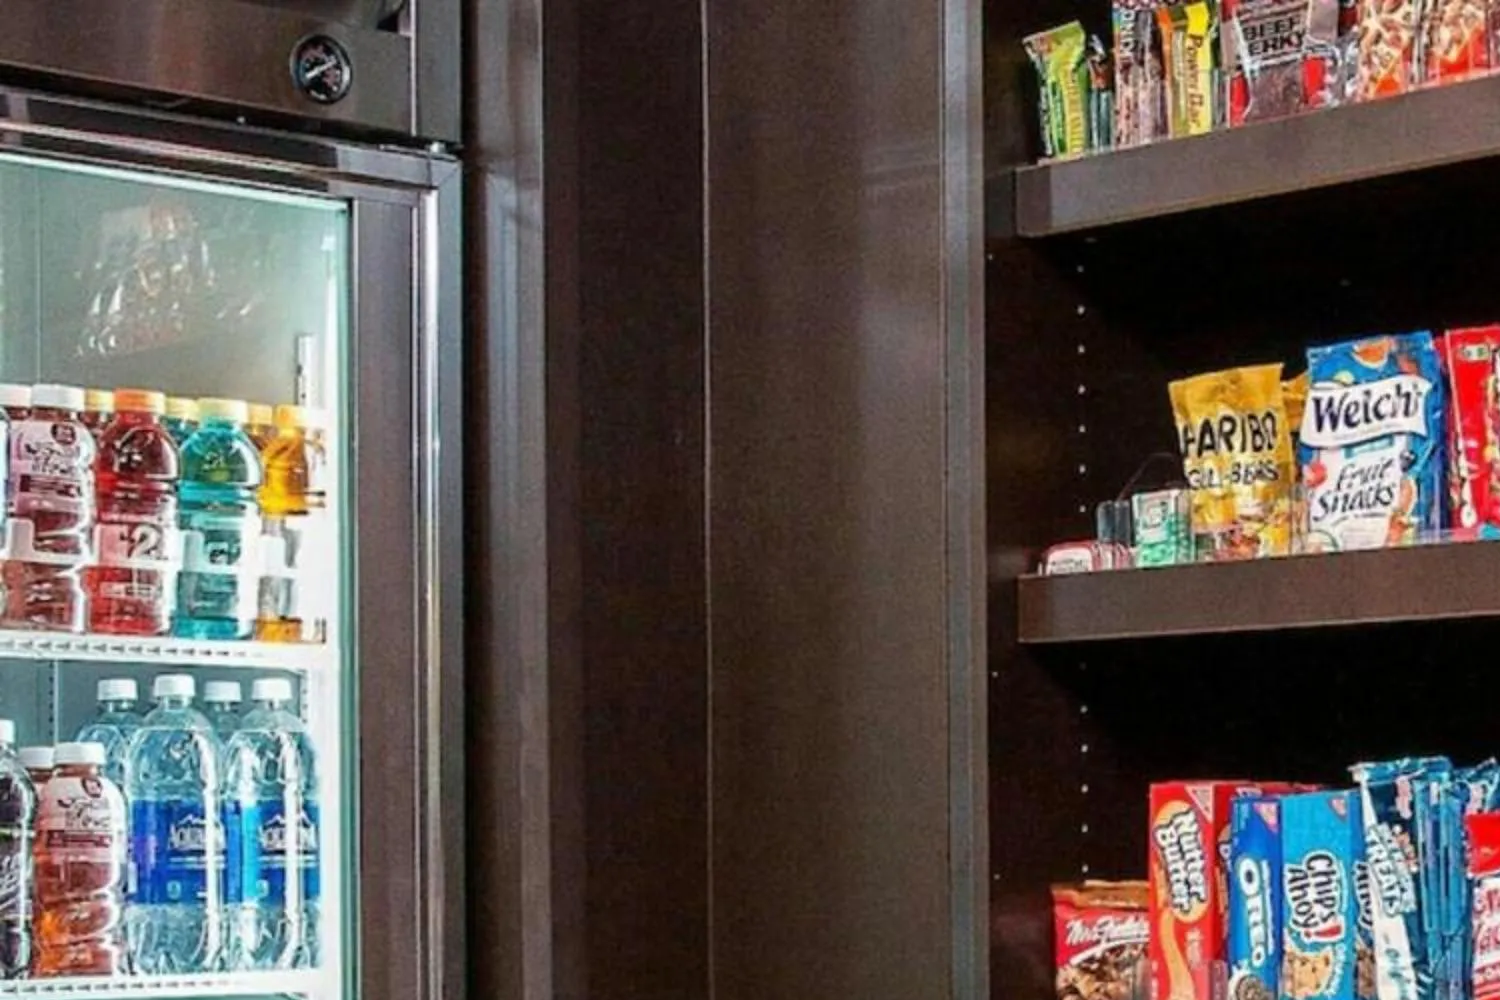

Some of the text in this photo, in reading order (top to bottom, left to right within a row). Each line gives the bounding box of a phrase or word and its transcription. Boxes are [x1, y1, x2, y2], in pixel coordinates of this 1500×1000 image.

[1241, 16, 1301, 41] BEEF
[1244, 30, 1306, 54] ERKY
[1181, 410, 1278, 459] HARIBO
[1337, 455, 1396, 492] Fruit
[1312, 483, 1397, 522] Snacks
[1153, 825, 1193, 917] Butter
[1172, 810, 1207, 903] Nutter
[1305, 853, 1339, 924] Chips
